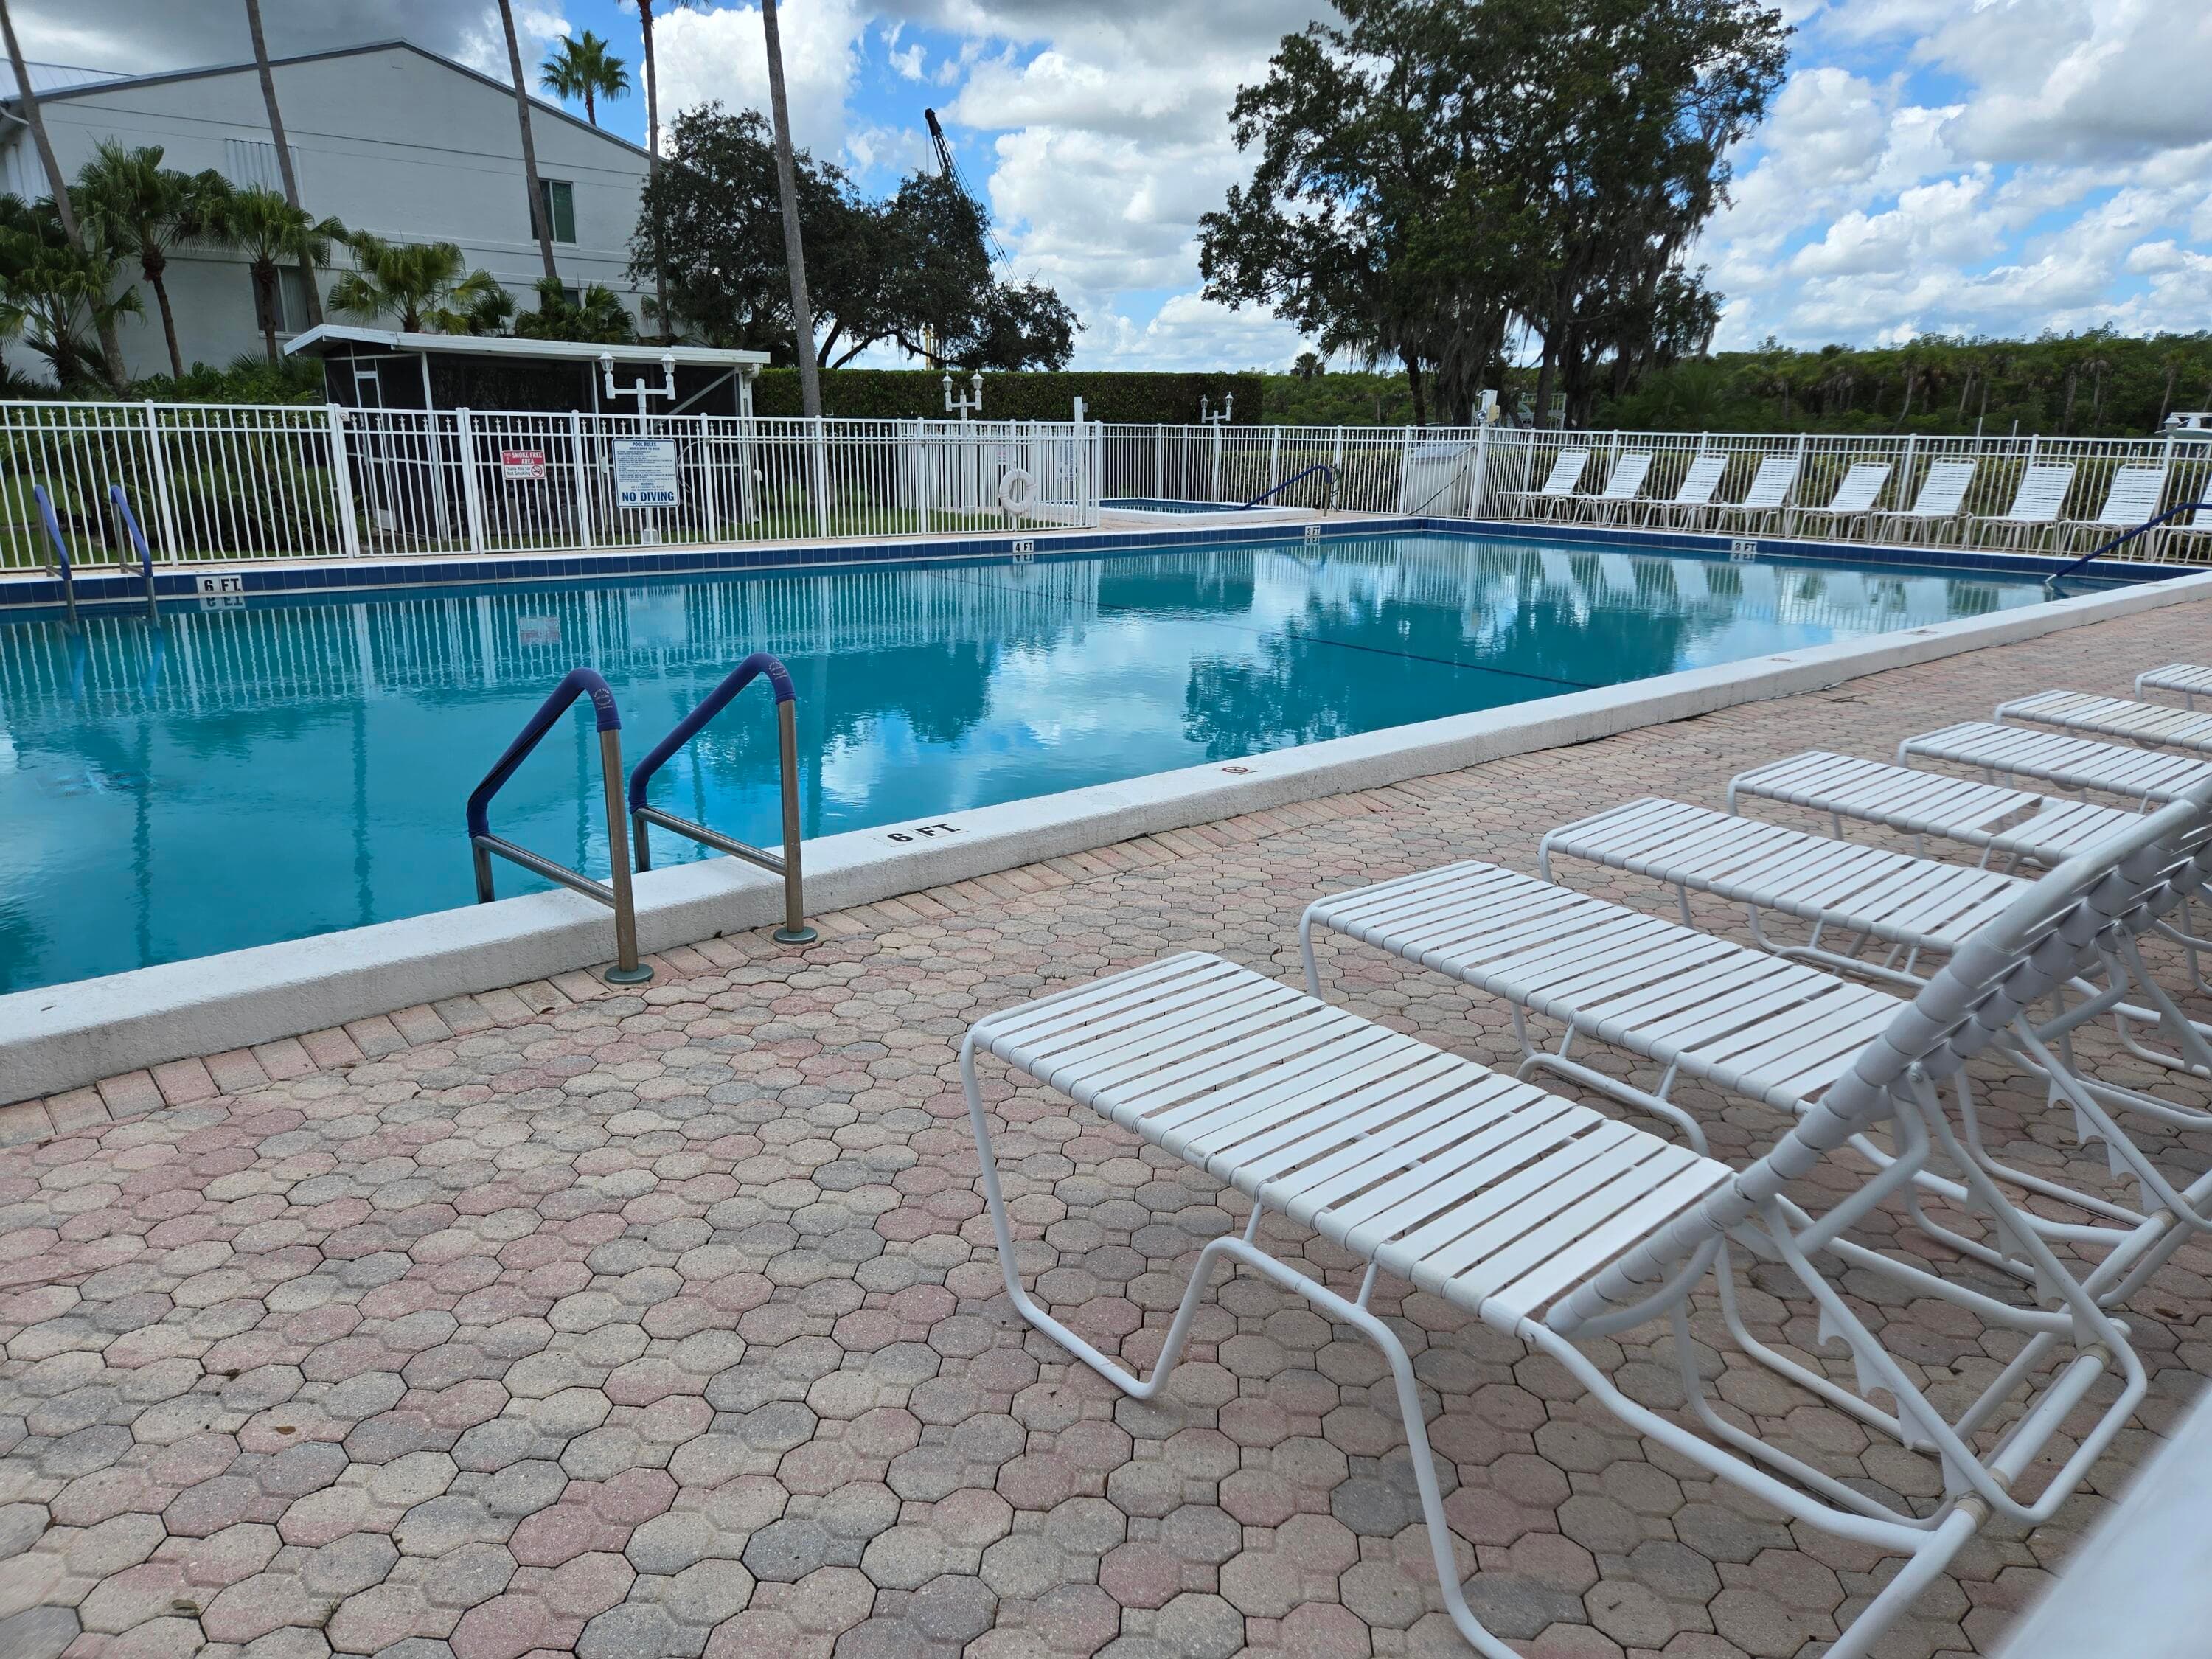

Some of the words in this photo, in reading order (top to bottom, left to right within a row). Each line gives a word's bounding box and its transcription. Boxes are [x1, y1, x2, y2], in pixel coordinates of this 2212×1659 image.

[622, 492, 636, 502] NO
[640, 491, 675, 502] DIVING
[1307, 527, 1311, 535] 3
[1015, 543, 1020, 552] 4
[1023, 542, 1033, 551] FT
[204, 579, 214, 591] 6
[887, 833, 914, 842] 6
